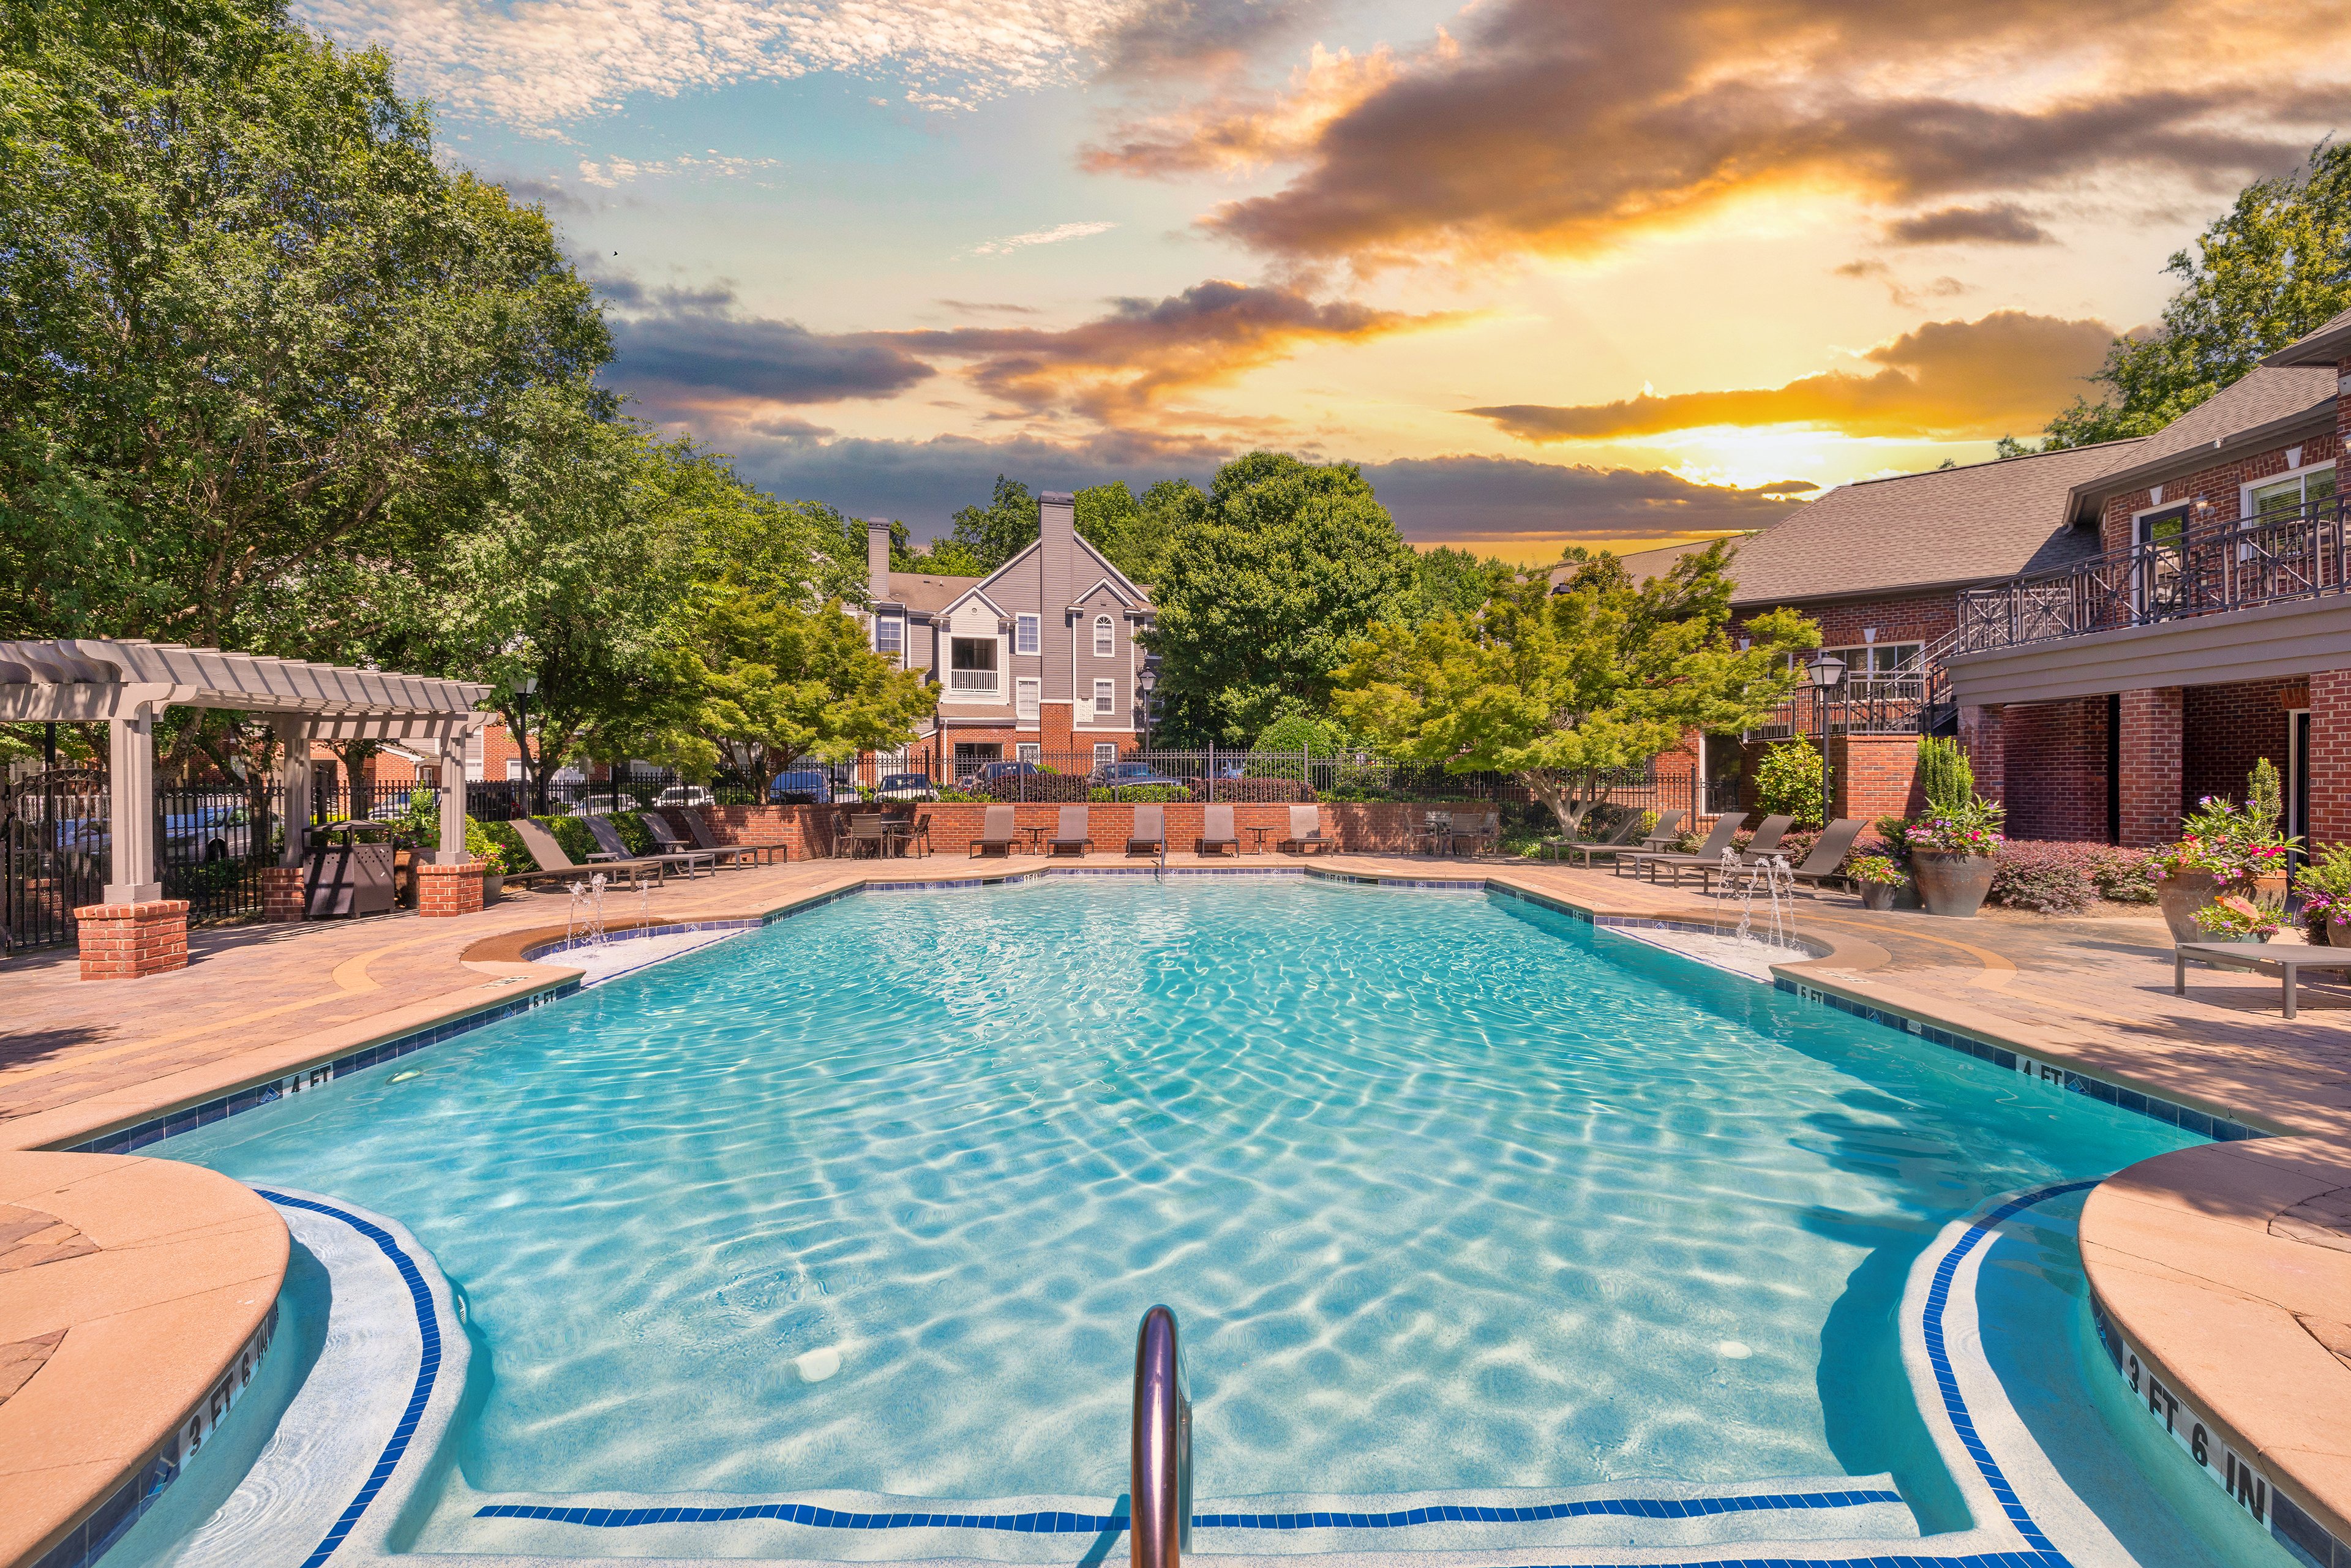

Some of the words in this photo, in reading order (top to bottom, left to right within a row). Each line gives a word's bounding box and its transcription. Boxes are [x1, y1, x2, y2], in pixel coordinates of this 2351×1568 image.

[778, 912, 783, 921] FT
[1578, 912, 1583, 921] FT
[544, 989, 555, 1004] FT
[1810, 989, 1823, 1003] FT
[291, 1075, 302, 1093] 4
[310, 1065, 331, 1088] FT
[2023, 1060, 2033, 1076] 4
[2041, 1064, 2063, 1086] FT
[189, 1414, 201, 1457] 3
[210, 1370, 234, 1433] FT
[241, 1351, 251, 1389] 6
[256, 1318, 269, 1367] IN
[2128, 1354, 2140, 1394] 3
[2149, 1374, 2179, 1436] FT
[2191, 1422, 2208, 1468] 6
[2225, 1450, 2265, 1526] IN
